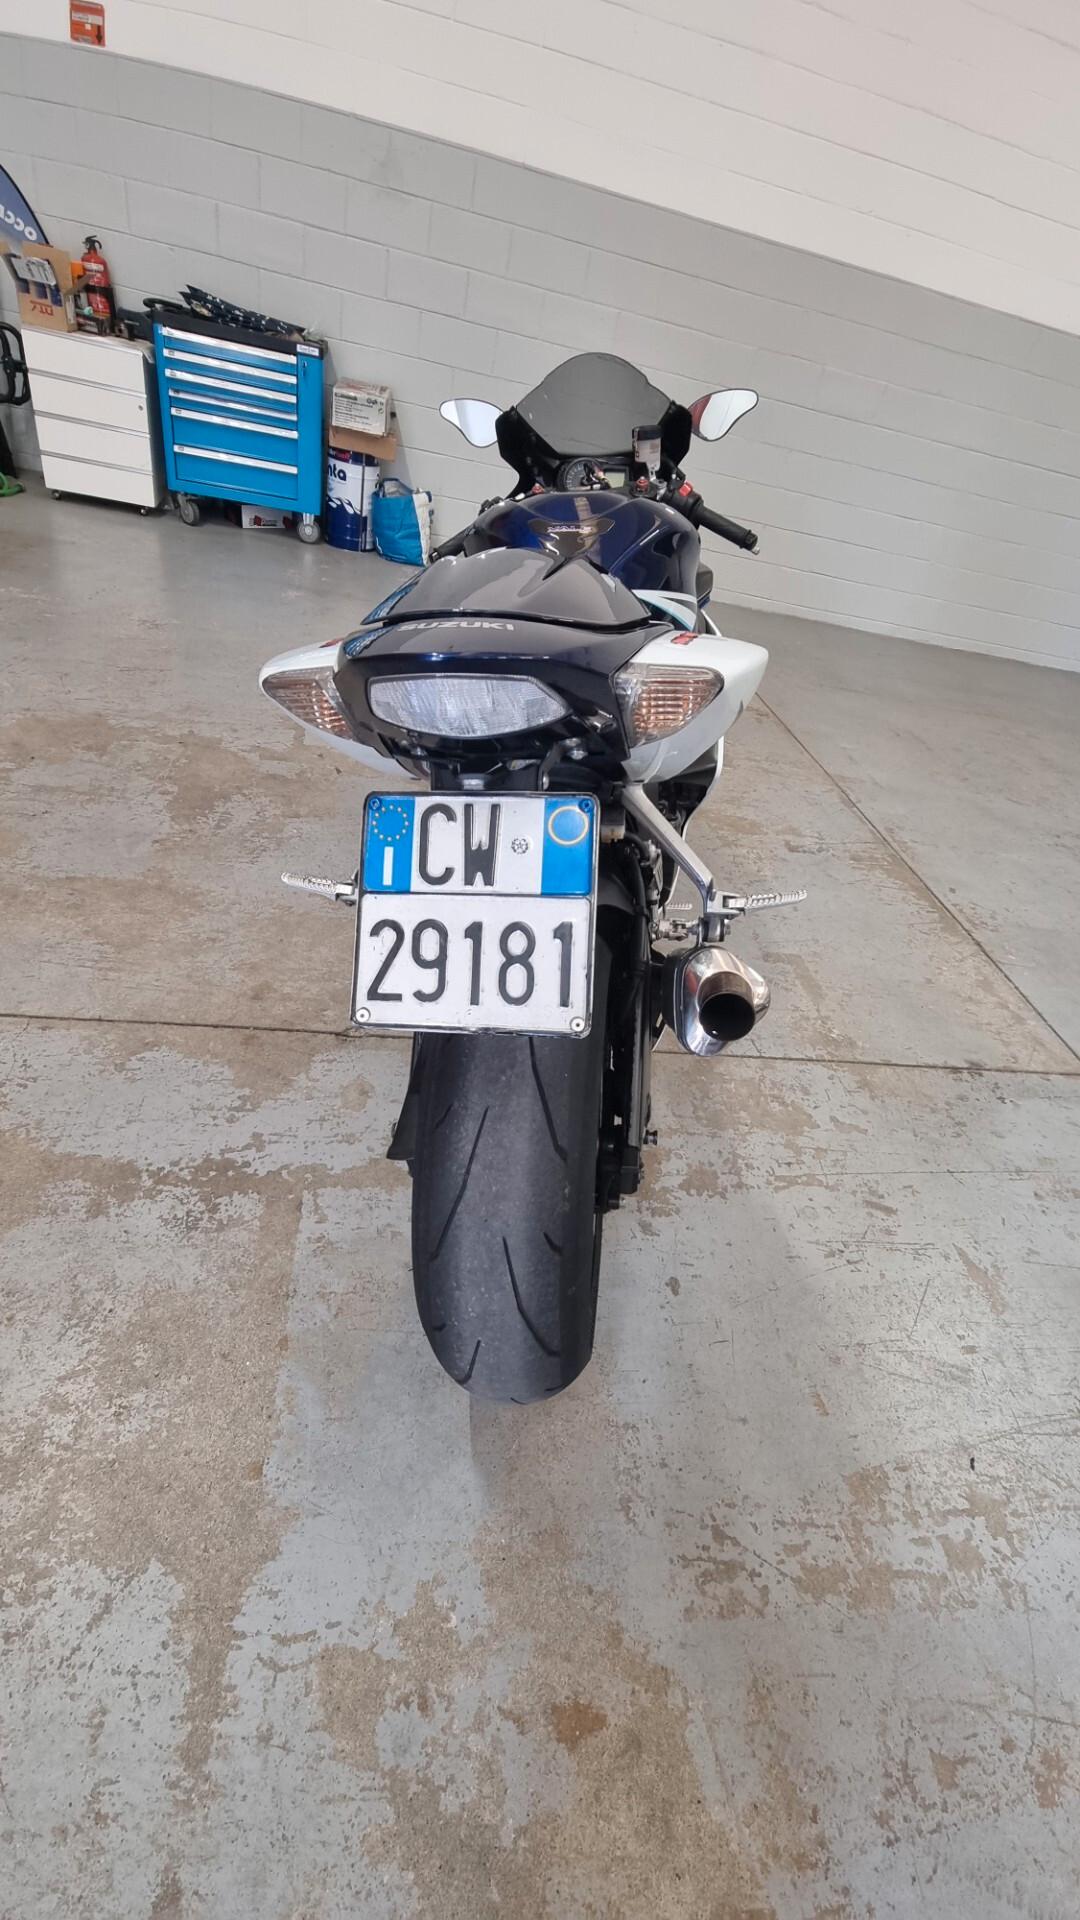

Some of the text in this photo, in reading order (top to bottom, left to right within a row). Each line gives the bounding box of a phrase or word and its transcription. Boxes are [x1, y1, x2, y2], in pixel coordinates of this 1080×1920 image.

[397, 620, 515, 632] SUZUKI
[418, 803, 501, 887] CW
[367, 918, 573, 1008] 29181
